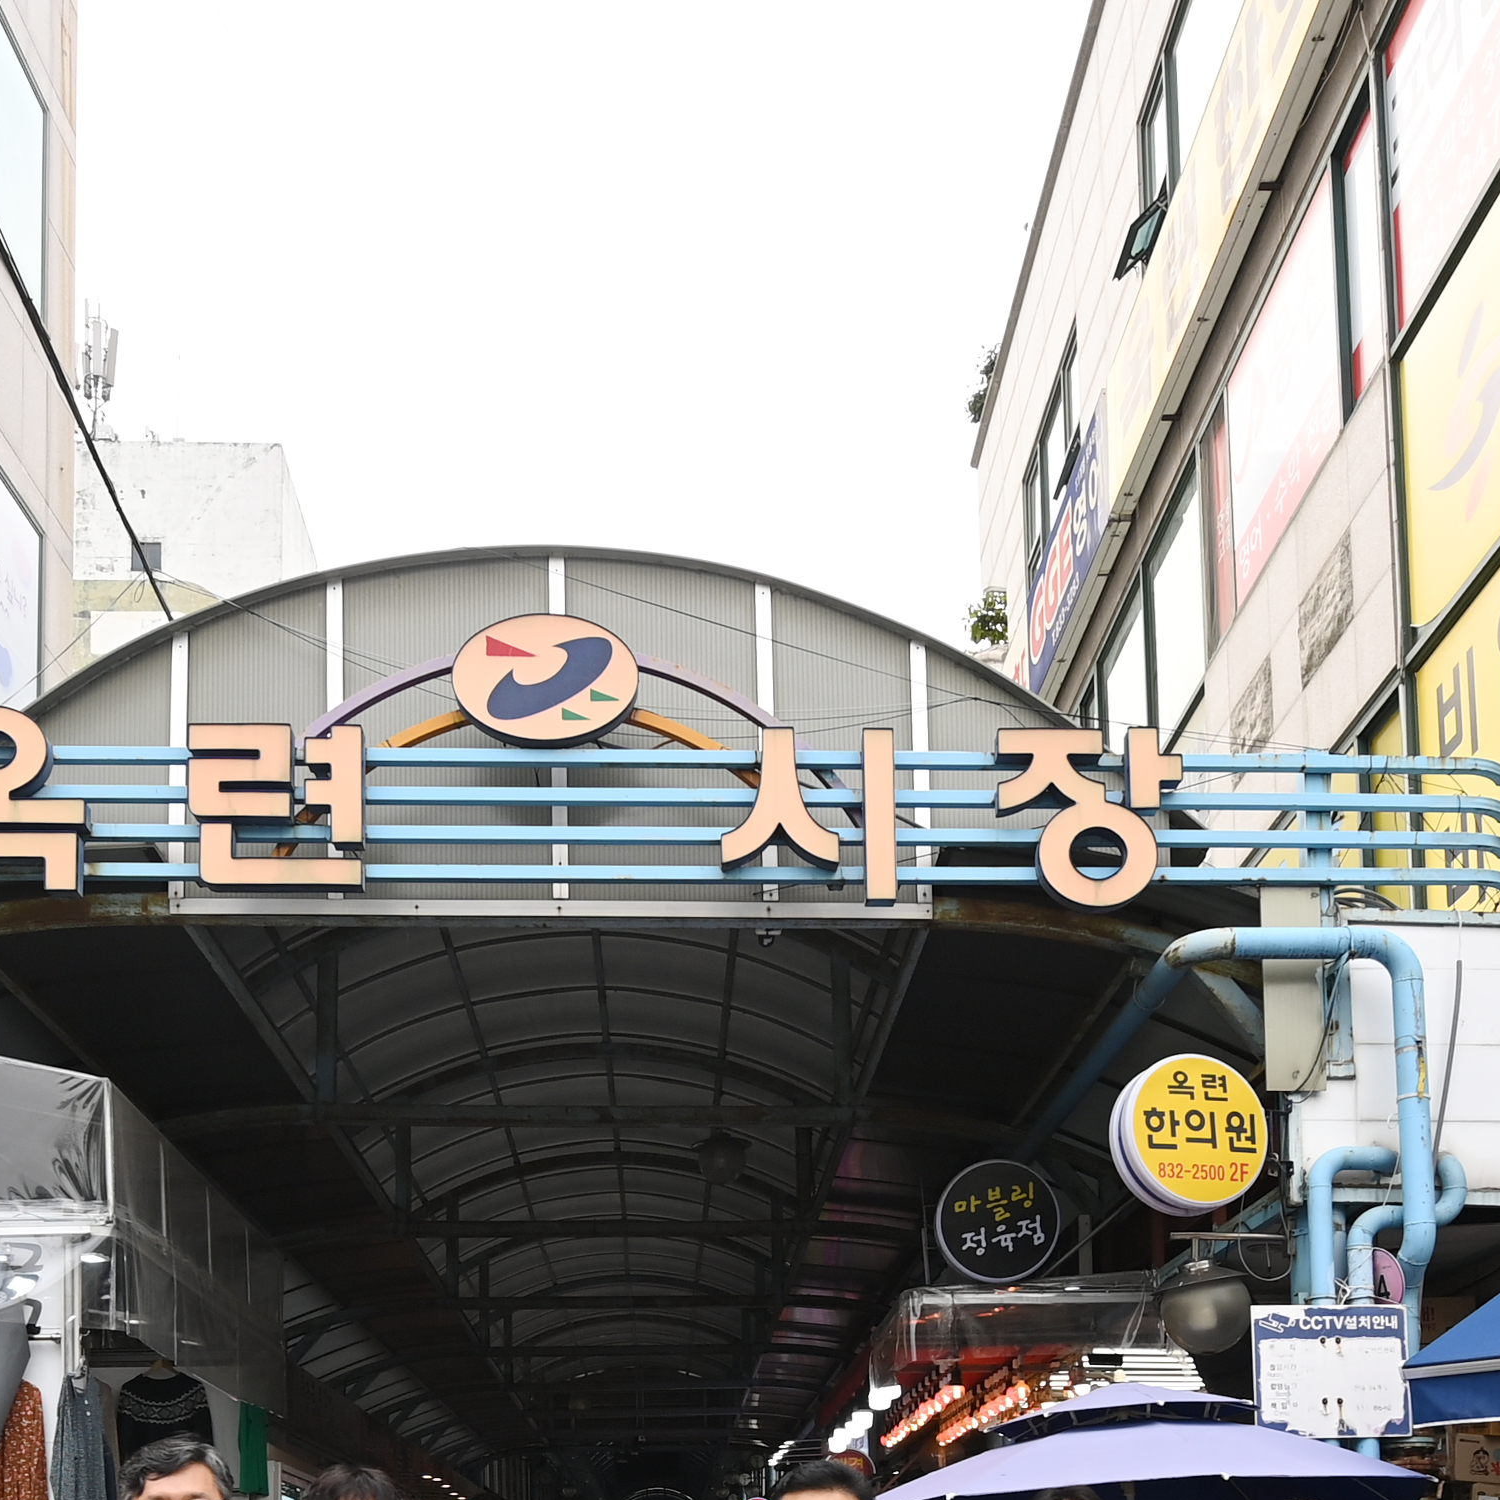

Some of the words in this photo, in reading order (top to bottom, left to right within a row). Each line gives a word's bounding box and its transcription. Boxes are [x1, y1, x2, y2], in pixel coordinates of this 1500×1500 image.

[1167, 1071, 1231, 1102] 옥련
[1142, 1106, 1258, 1154] 한의원
[1157, 1161, 1226, 1183] 832-2500
[1229, 1160, 1250, 1183] 2F
[953, 1181, 1036, 1224] 마블링
[961, 1214, 1045, 1258] 정육점
[1299, 1315, 1398, 1331] CCTV설치안내
